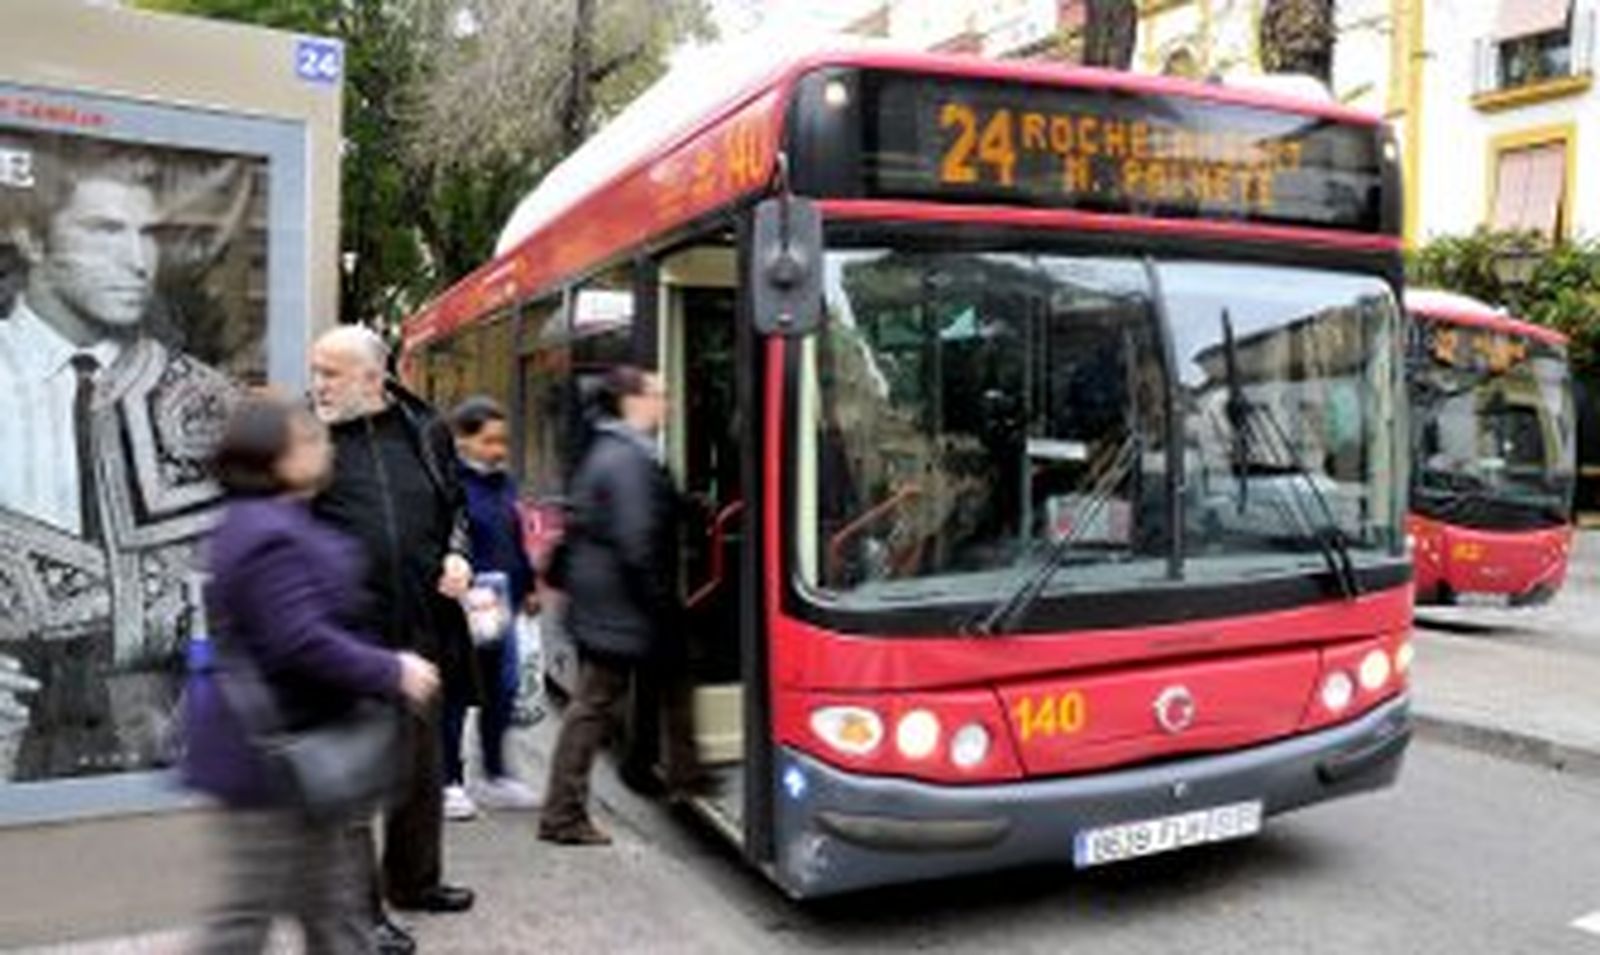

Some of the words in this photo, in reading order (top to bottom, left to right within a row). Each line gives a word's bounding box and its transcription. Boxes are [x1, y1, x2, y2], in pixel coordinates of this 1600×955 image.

[300, 50, 338, 77] 24
[940, 104, 1016, 187] 24
[1015, 690, 1085, 740] 140
